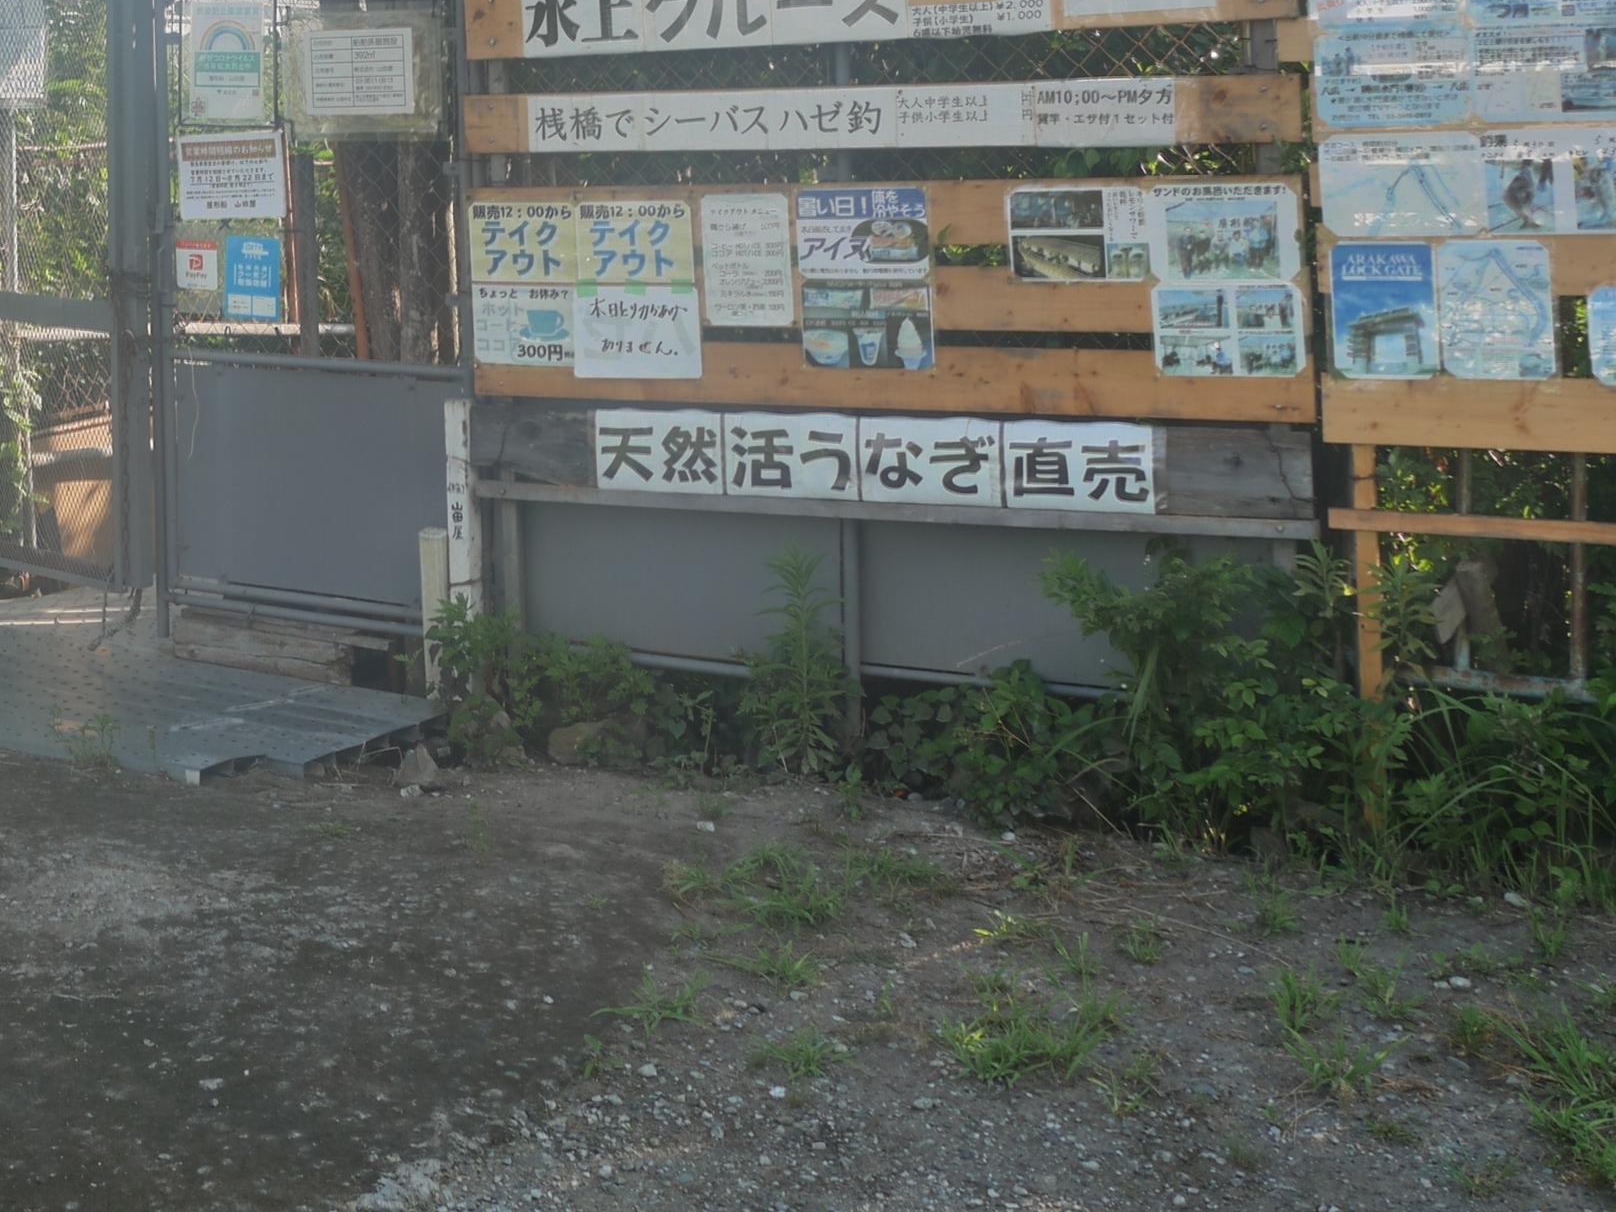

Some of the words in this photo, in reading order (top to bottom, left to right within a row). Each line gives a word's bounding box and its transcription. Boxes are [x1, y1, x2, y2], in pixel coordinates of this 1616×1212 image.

[534, 101, 882, 143] 桟橋でシーバスハゼ釣
[481, 220, 558, 247] テイク
[589, 219, 670, 247] テイク
[485, 249, 561, 276] アウト
[593, 248, 674, 277] アウト
[1342, 264, 1381, 276] LOCK
[1385, 264, 1422, 276] GATE
[1346, 254, 1416, 265] ARAKAWA
[185, 272, 208, 280] PayPay
[479, 287, 518, 299] ちょっと
[481, 302, 524, 317] ホット
[517, 344, 564, 361] 300円
[598, 425, 1151, 502] 天然活うなぎ直売
